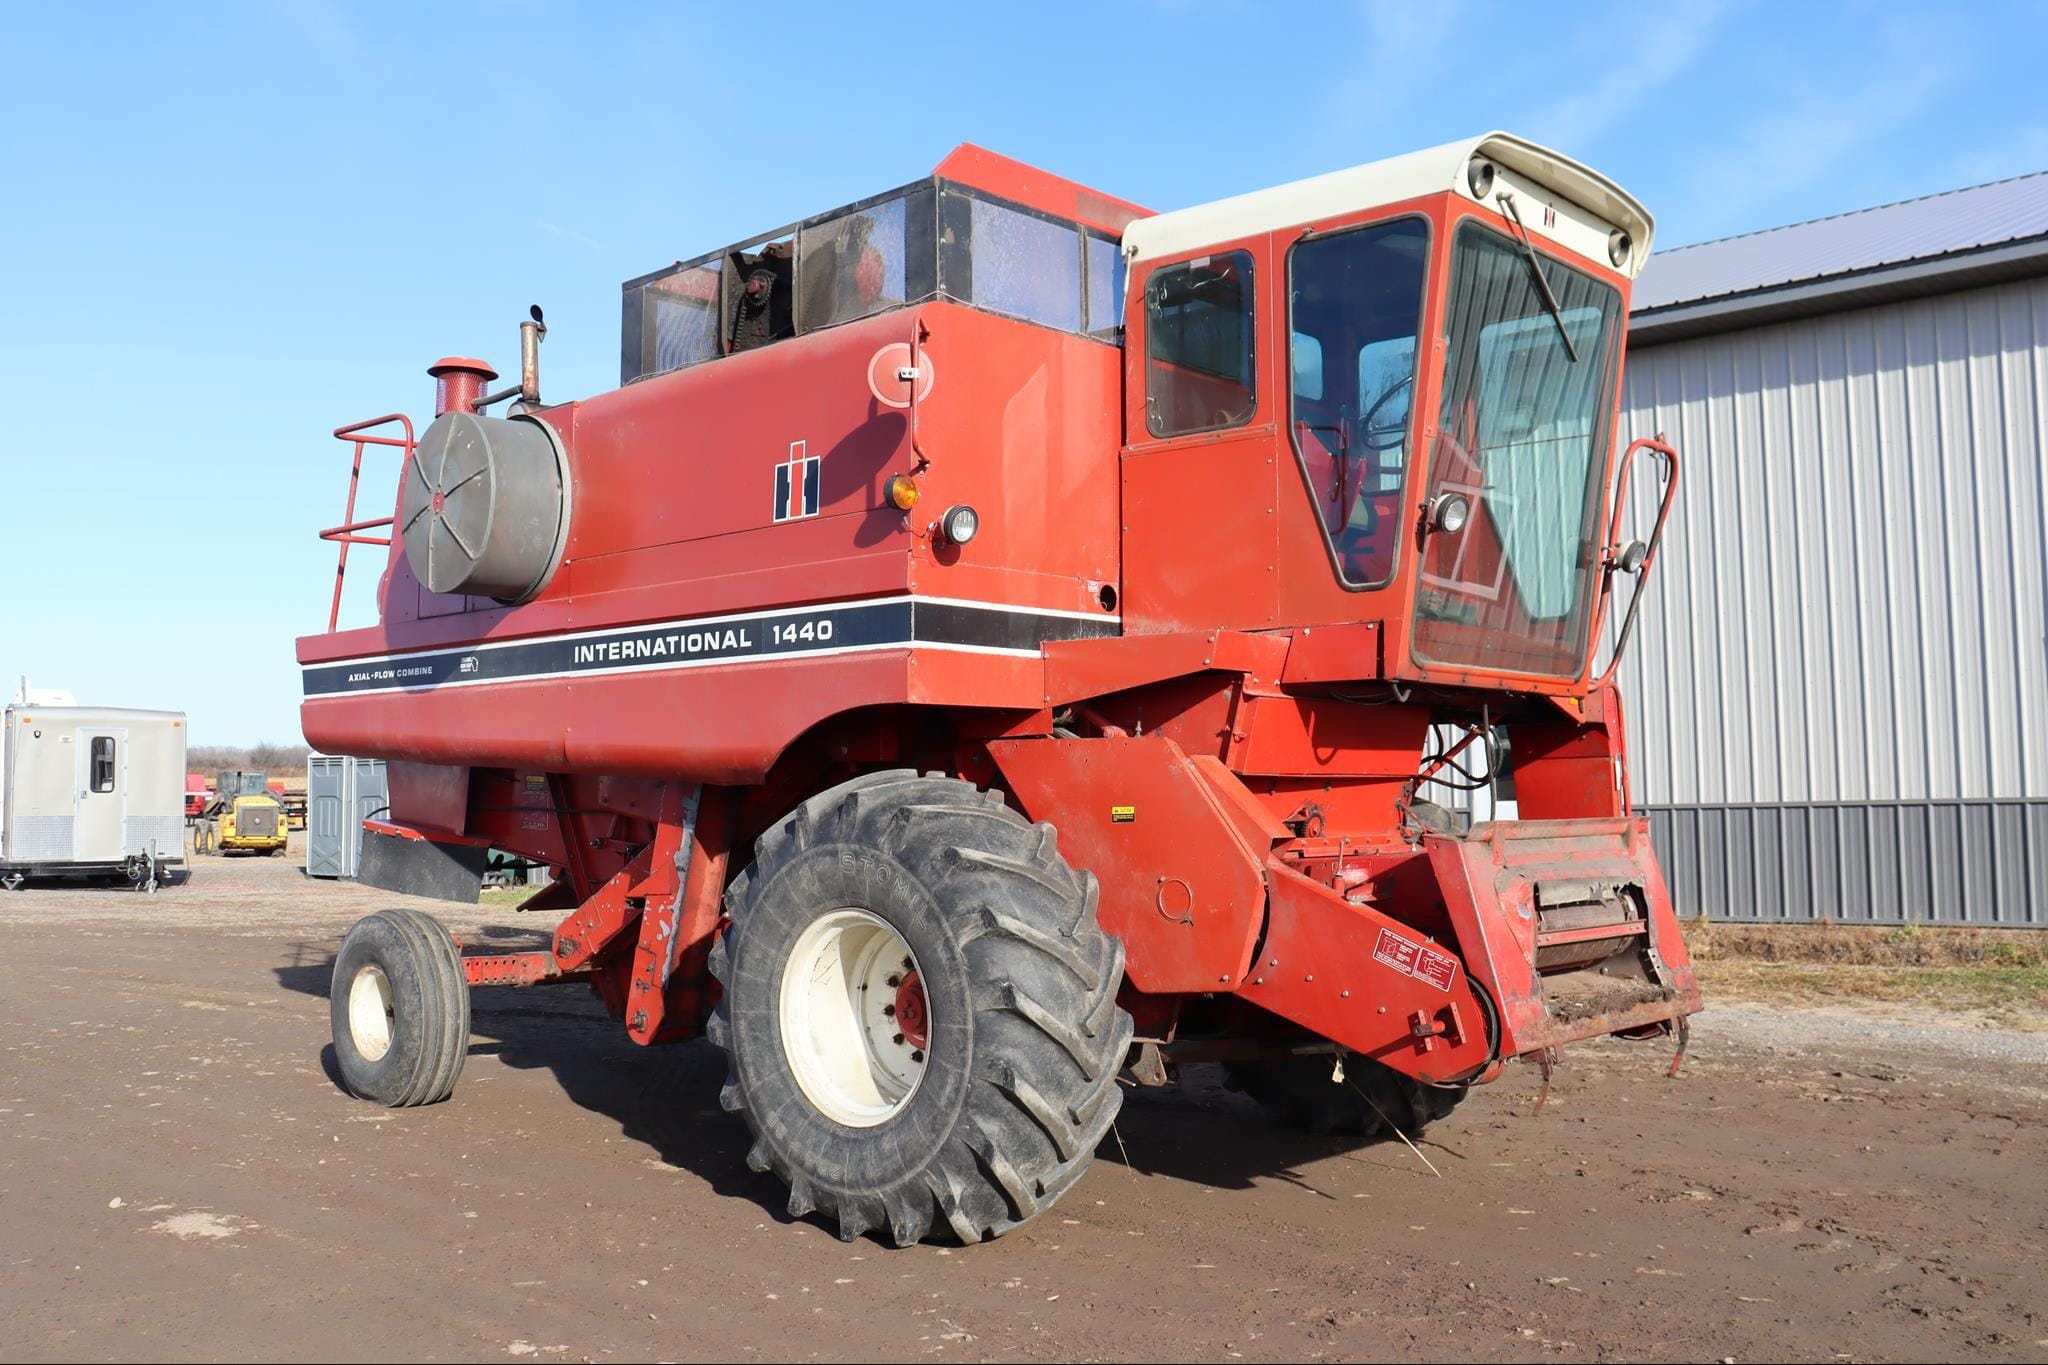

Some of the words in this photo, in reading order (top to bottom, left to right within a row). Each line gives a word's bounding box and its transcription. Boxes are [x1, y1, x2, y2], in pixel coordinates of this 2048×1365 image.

[574, 628, 752, 664] INTERNATIONAL
[772, 619, 833, 645] 1440
[348, 669, 395, 682] AXIAL-FLOW
[396, 666, 433, 677] COMBINE
[840, 851, 927, 930] STOMIL
